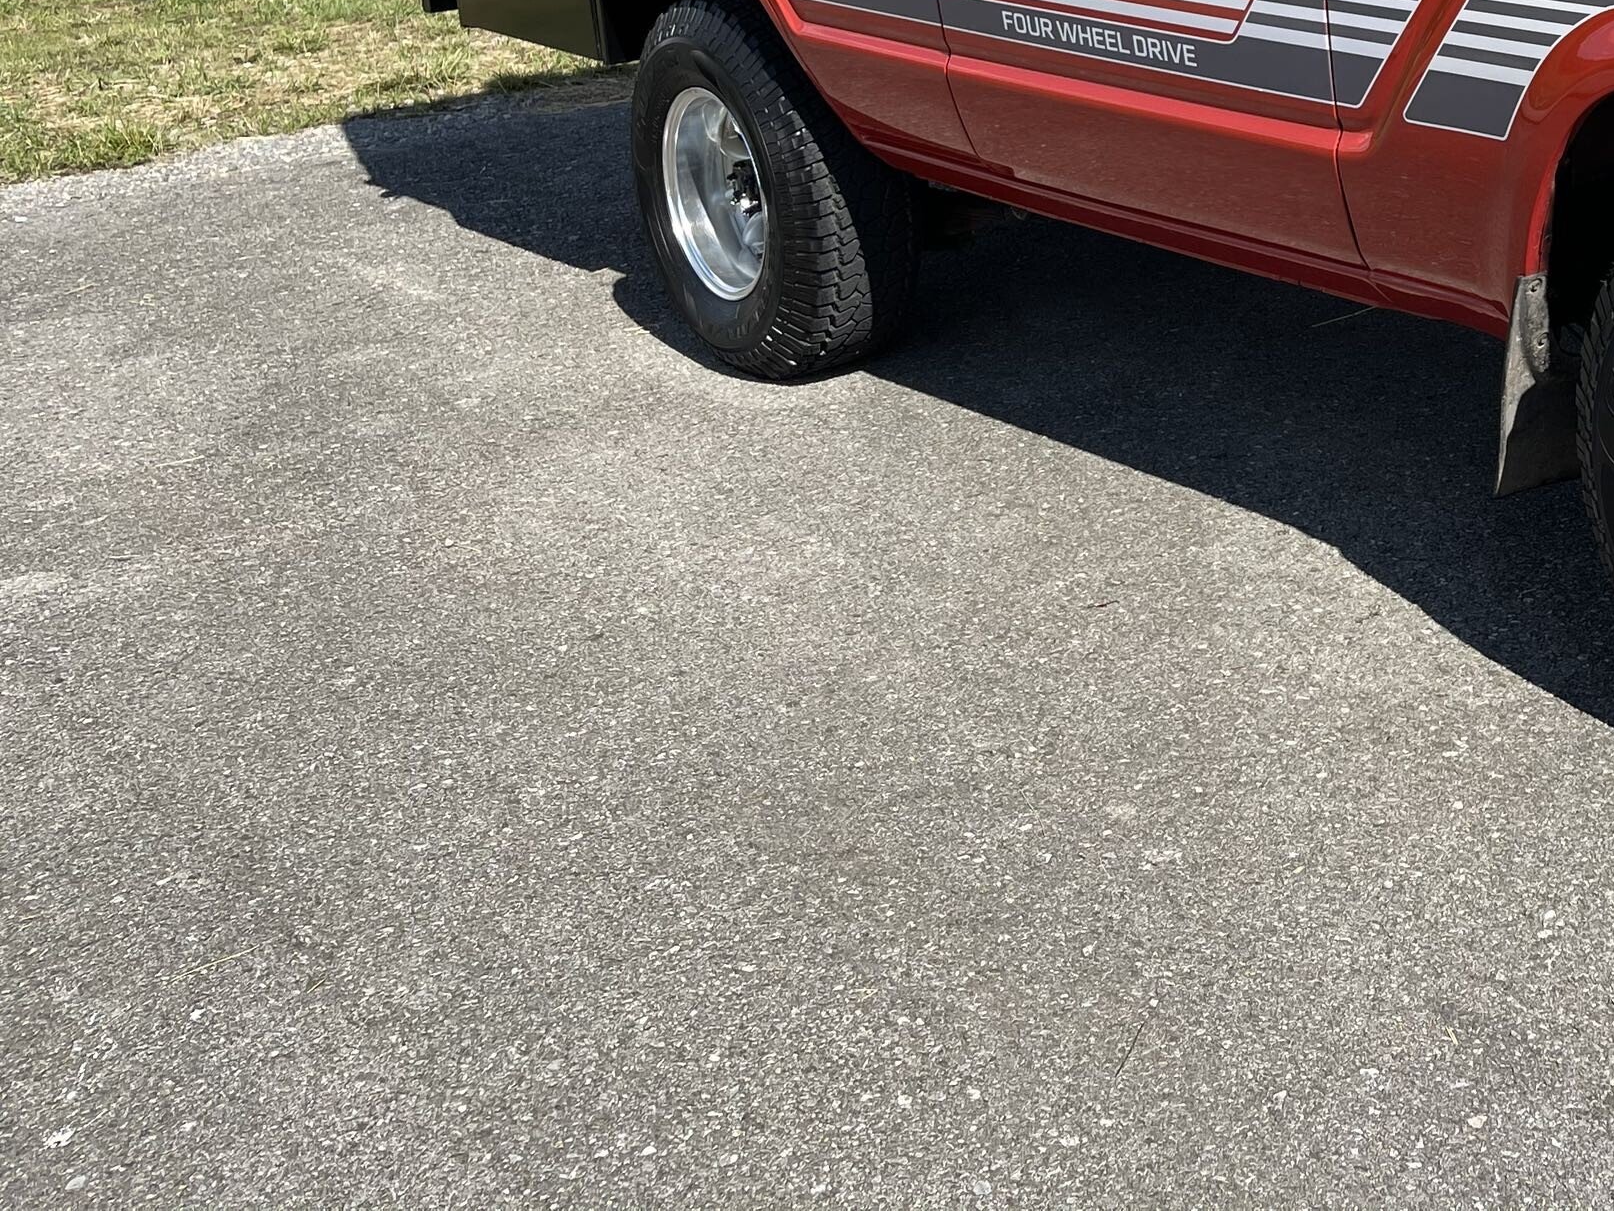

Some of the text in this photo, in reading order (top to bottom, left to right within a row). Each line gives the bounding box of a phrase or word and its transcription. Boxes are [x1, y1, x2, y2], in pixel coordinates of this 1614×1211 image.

[1001, 10, 1197, 67] FOUR WHEEL DRIVE
